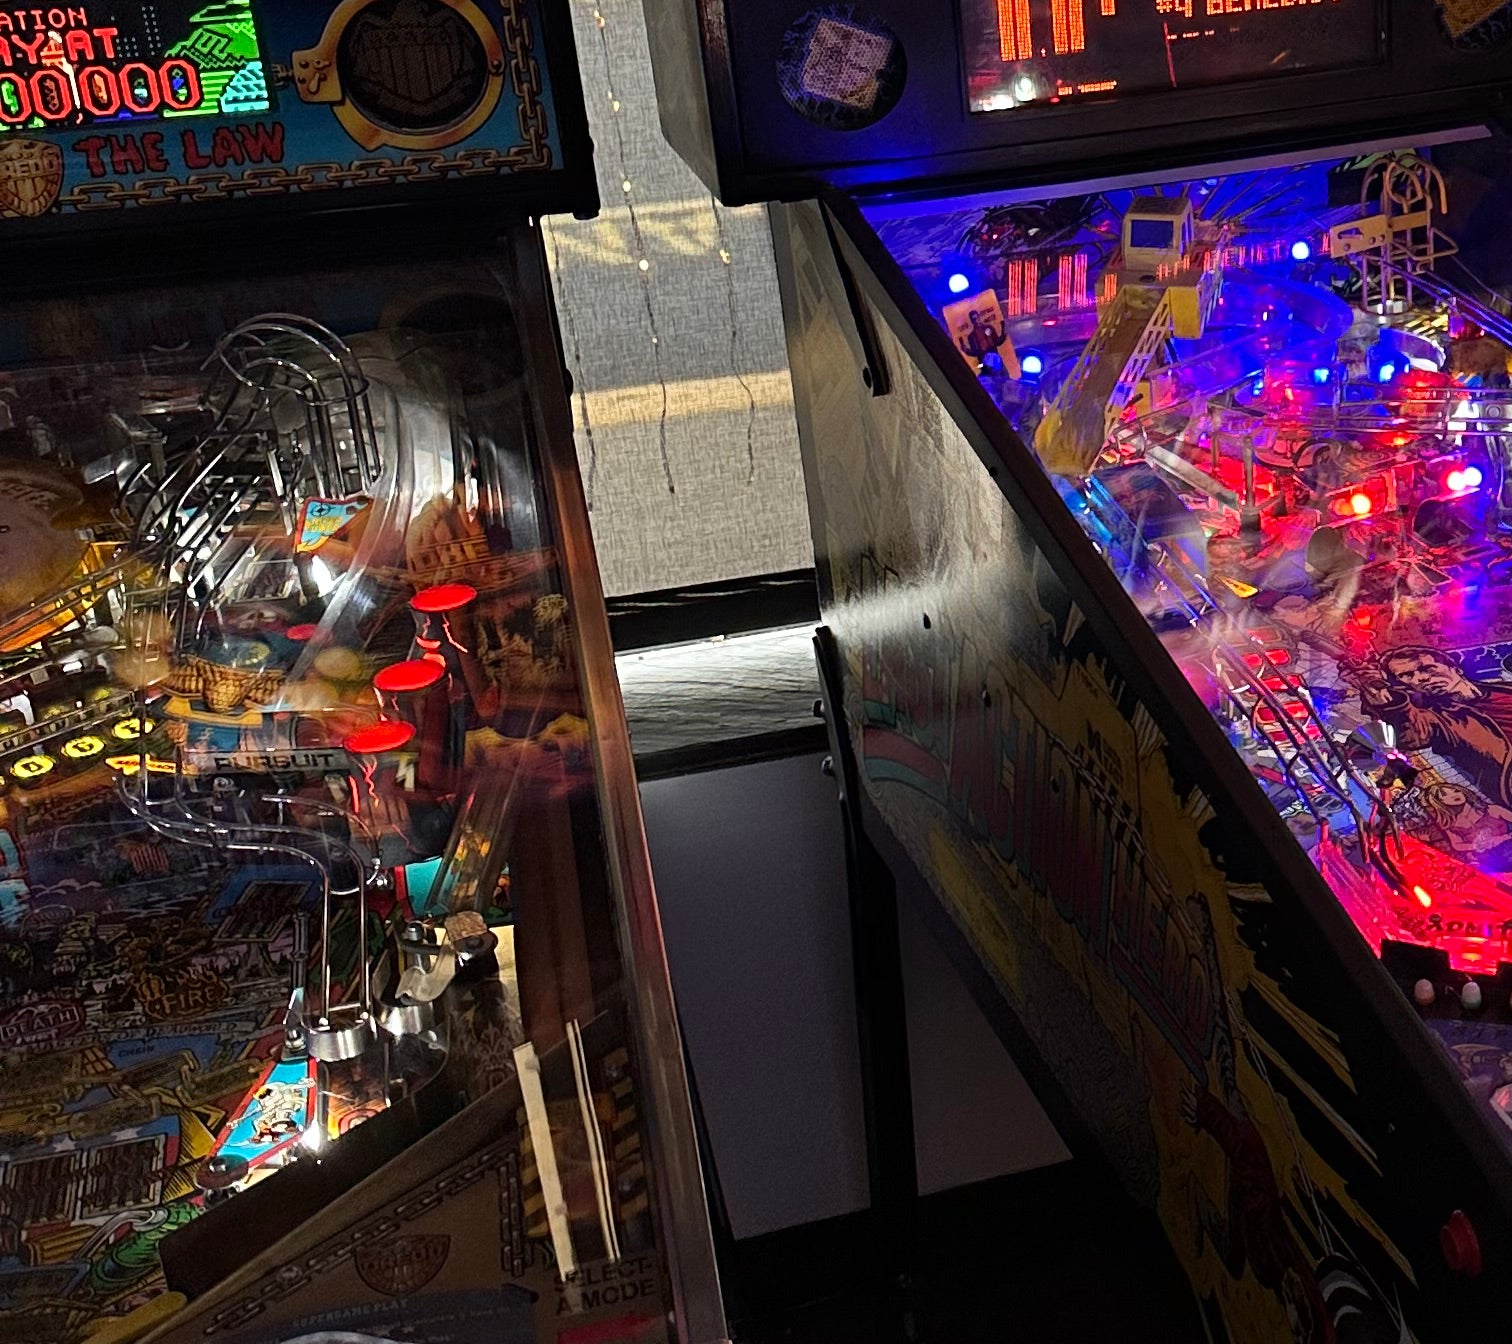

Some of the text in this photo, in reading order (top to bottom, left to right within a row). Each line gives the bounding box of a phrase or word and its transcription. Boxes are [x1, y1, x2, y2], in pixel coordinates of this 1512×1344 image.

[73, 122, 285, 178] THE LAW
[214, 753, 336, 771] PURSUIT
[580, 1277, 657, 1310] MODE
